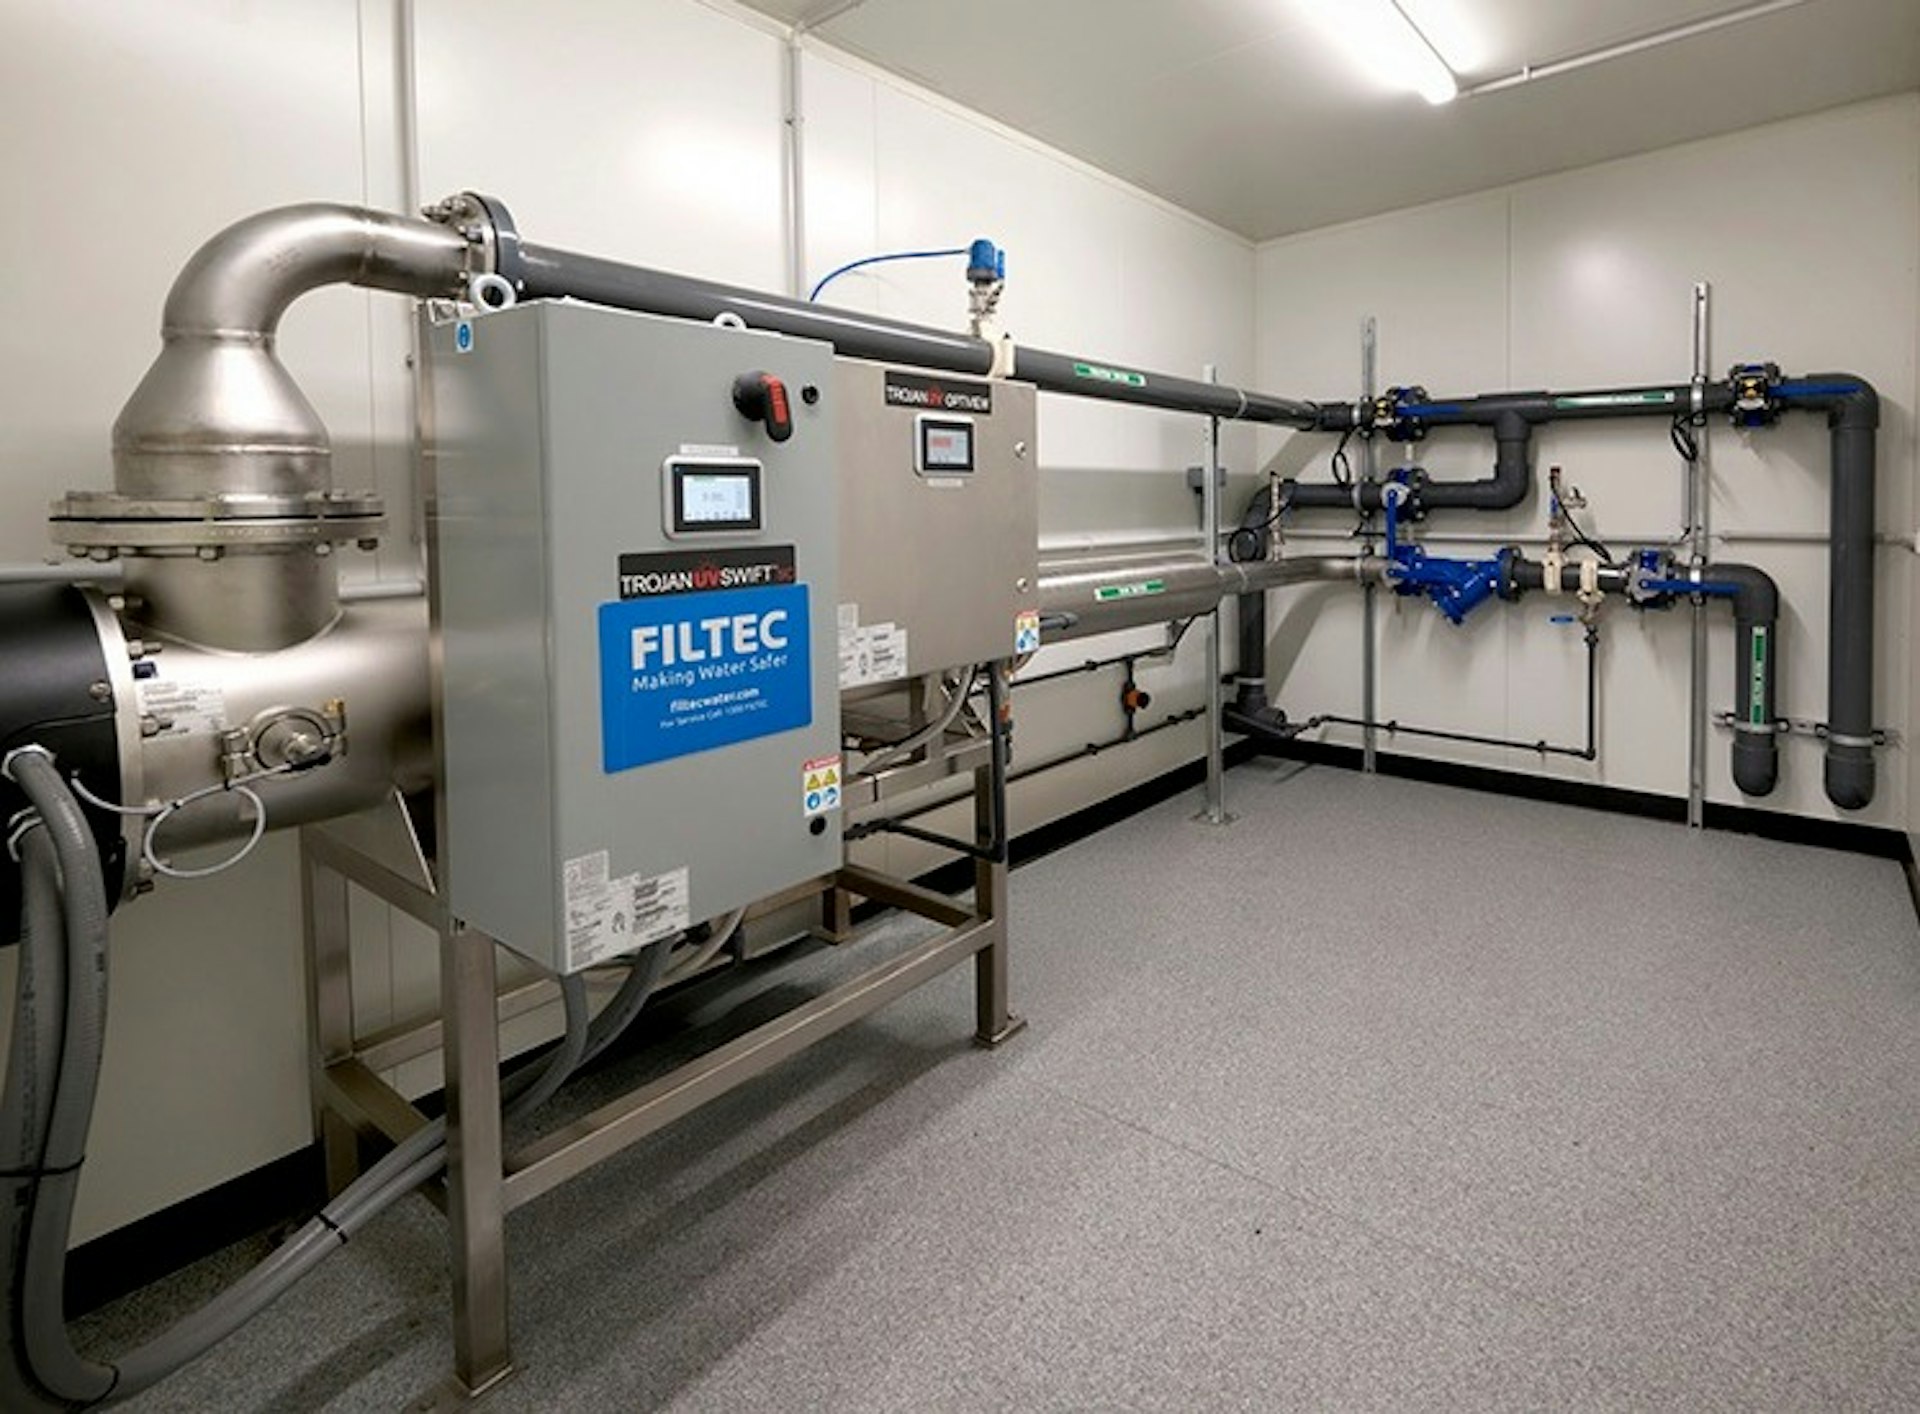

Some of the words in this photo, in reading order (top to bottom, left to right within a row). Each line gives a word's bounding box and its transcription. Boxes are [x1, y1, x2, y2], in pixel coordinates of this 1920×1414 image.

[631, 610, 788, 671] FILTEC
[631, 669, 696, 693] Making
[698, 660, 747, 680] Water
[749, 653, 789, 673] Safer
